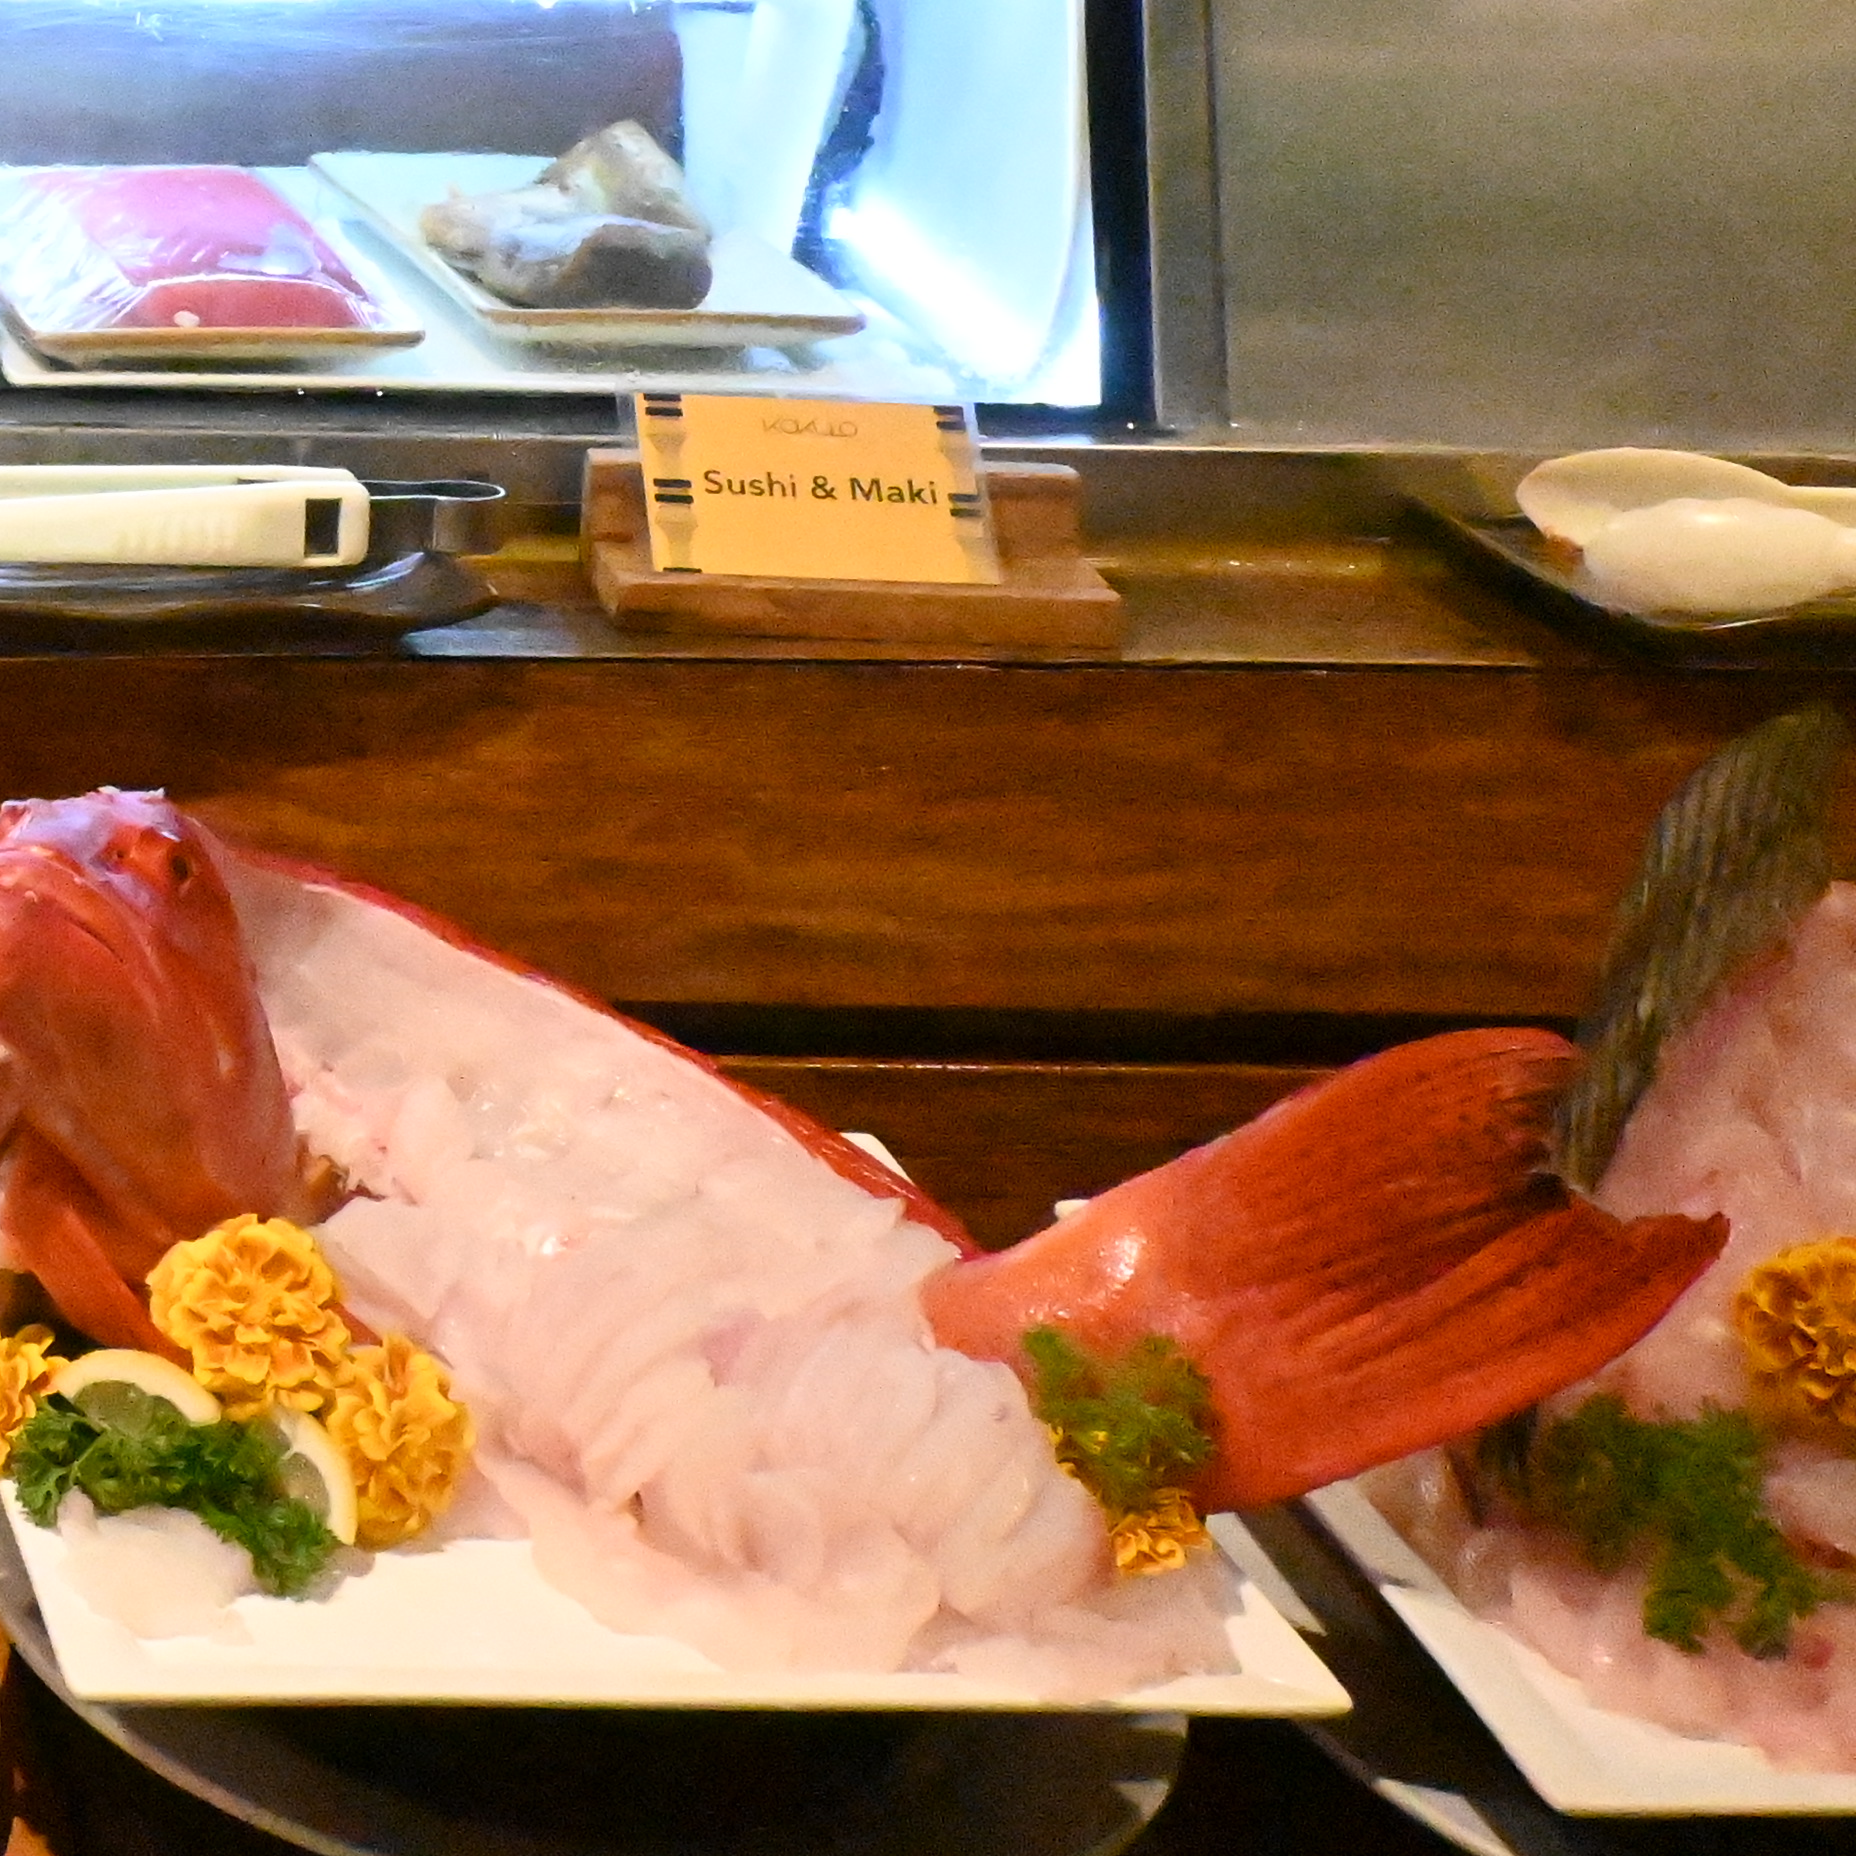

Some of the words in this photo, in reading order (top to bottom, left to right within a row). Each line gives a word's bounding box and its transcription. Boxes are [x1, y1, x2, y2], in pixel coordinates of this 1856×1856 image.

[703, 469, 797, 500] Sushi
[810, 475, 838, 501] &
[849, 476, 938, 505] Maki
